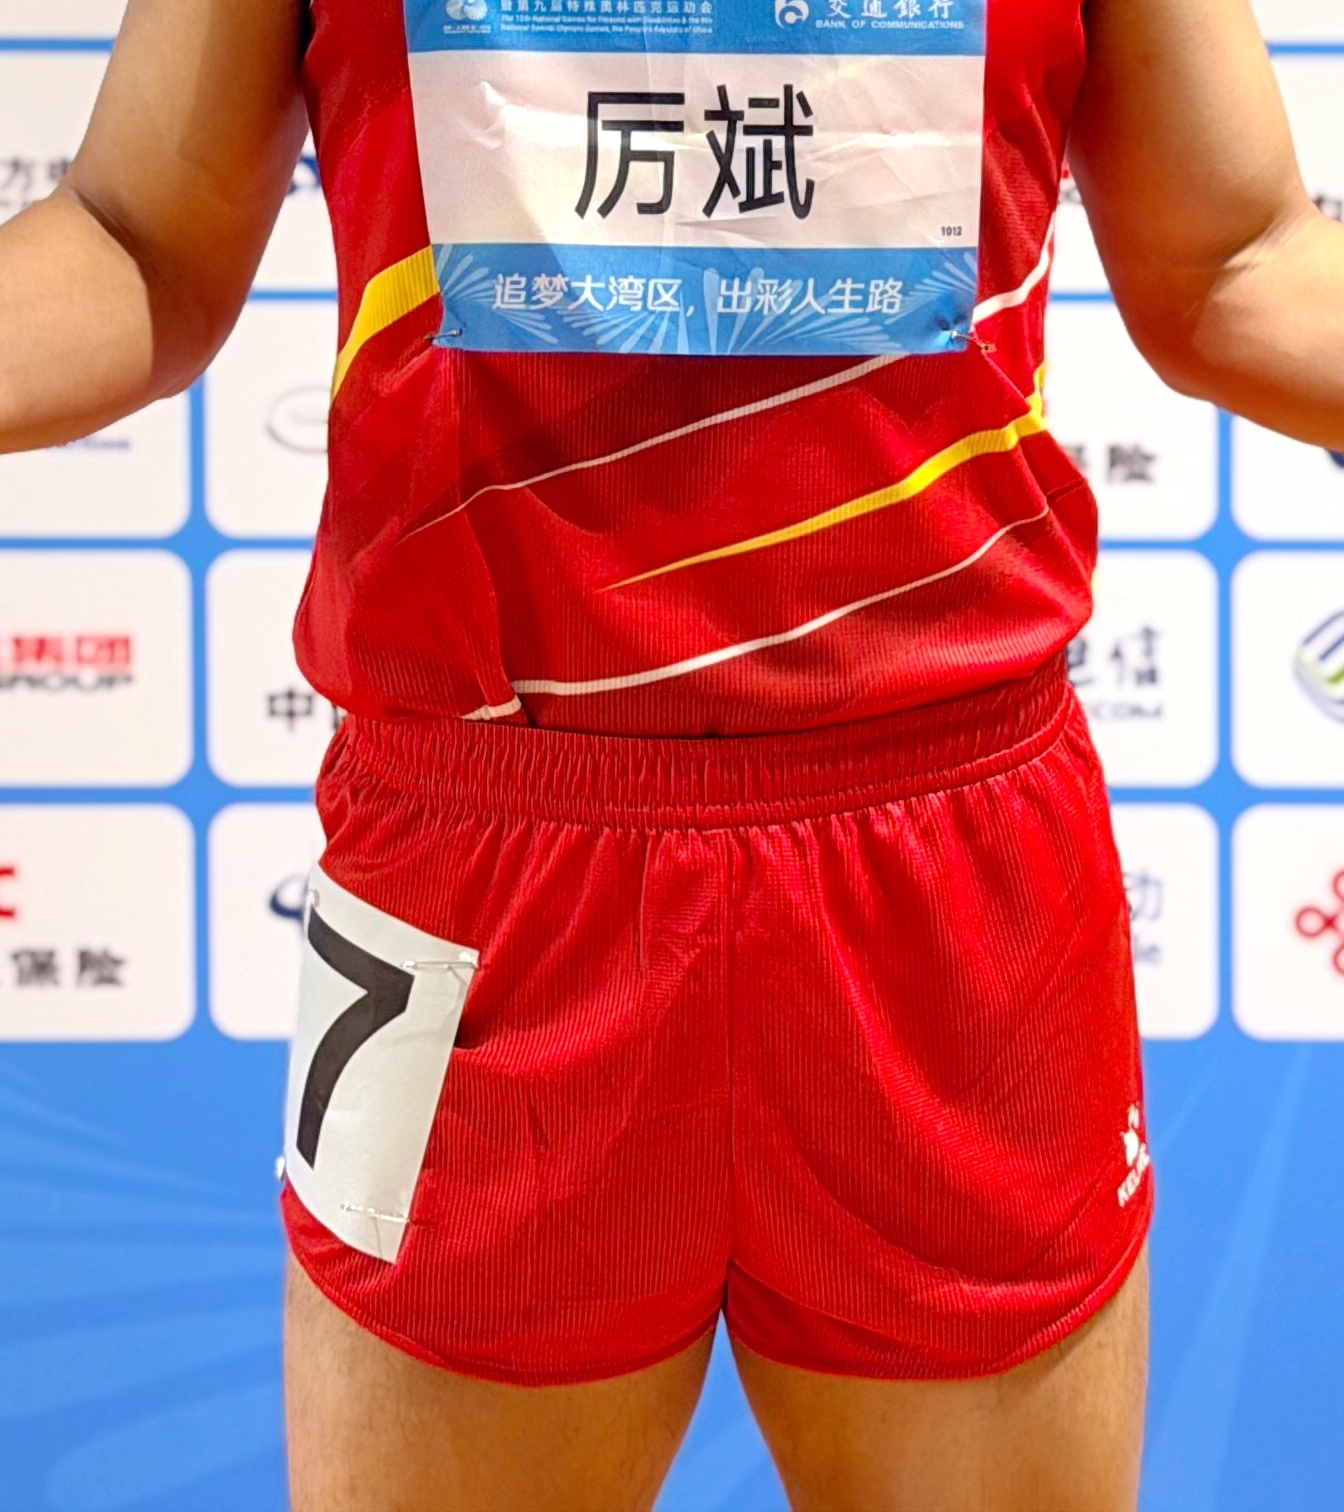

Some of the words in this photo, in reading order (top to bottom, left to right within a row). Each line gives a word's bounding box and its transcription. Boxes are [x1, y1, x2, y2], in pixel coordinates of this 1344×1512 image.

[816, 20, 846, 29] BANK
[851, 20, 865, 29] OF
[575, 84, 814, 220] 厉斌
[296, 905, 415, 1170] 7
